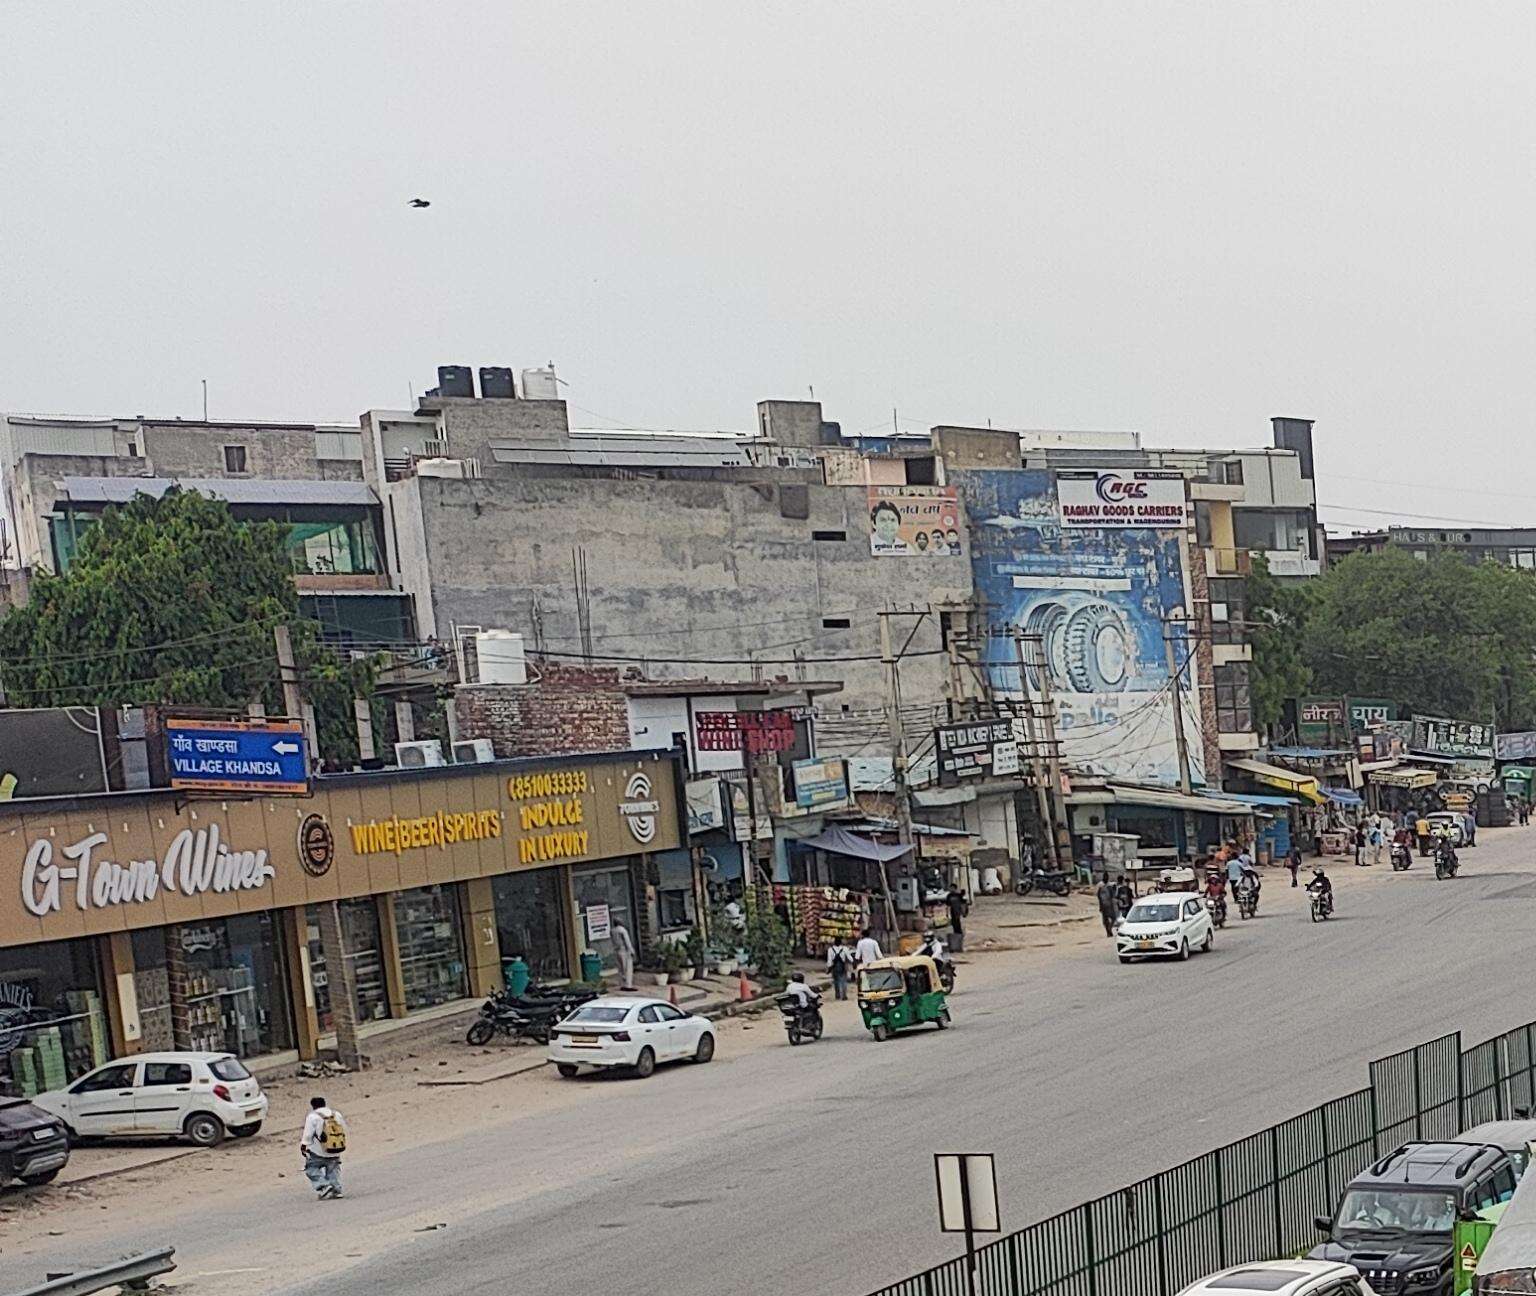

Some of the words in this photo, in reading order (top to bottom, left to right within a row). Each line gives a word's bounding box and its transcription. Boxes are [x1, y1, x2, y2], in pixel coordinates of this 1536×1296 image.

[1063, 505, 1100, 517] RAGHAV
[1103, 505, 1134, 517] GOODS
[1137, 505, 1183, 517] CARRIERS
[1393, 533, 1426, 543] HAUS
[1428, 533, 1436, 543] &
[1352, 705, 1389, 722] चाय
[174, 758, 224, 774] VILLAGE
[225, 760, 282, 775] KHANDSA
[520, 800, 584, 831] INDULGE
[520, 838, 535, 863] IN
[539, 831, 588, 862] LUXURY
[22, 832, 159, 916] G-Town
[162, 823, 275, 896] Wines
